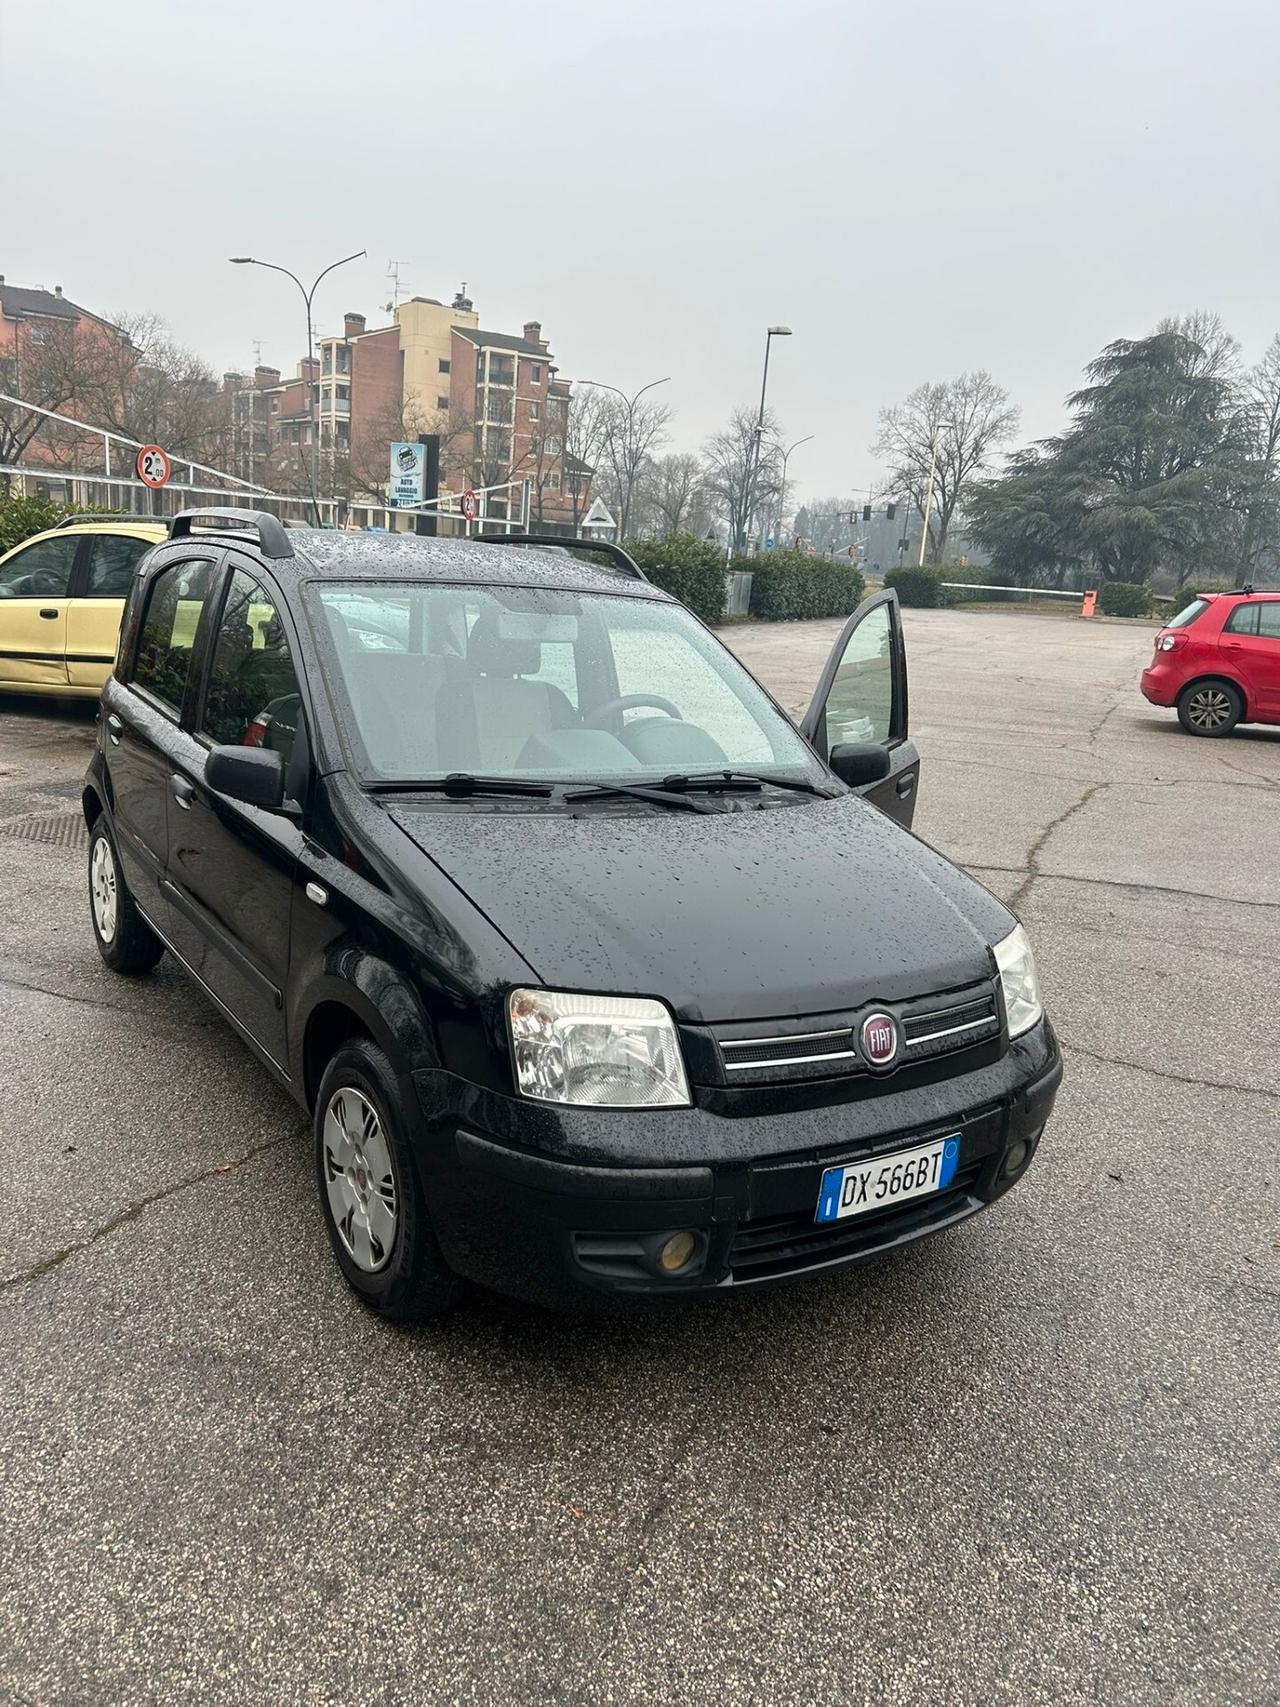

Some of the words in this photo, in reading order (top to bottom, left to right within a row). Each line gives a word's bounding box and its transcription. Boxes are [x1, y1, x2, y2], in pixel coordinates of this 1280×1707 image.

[870, 1027, 890, 1052] FIAT
[841, 1171, 871, 1208] DX
[875, 1151, 942, 1199] 566BT
[825, 1197, 832, 1216] I
